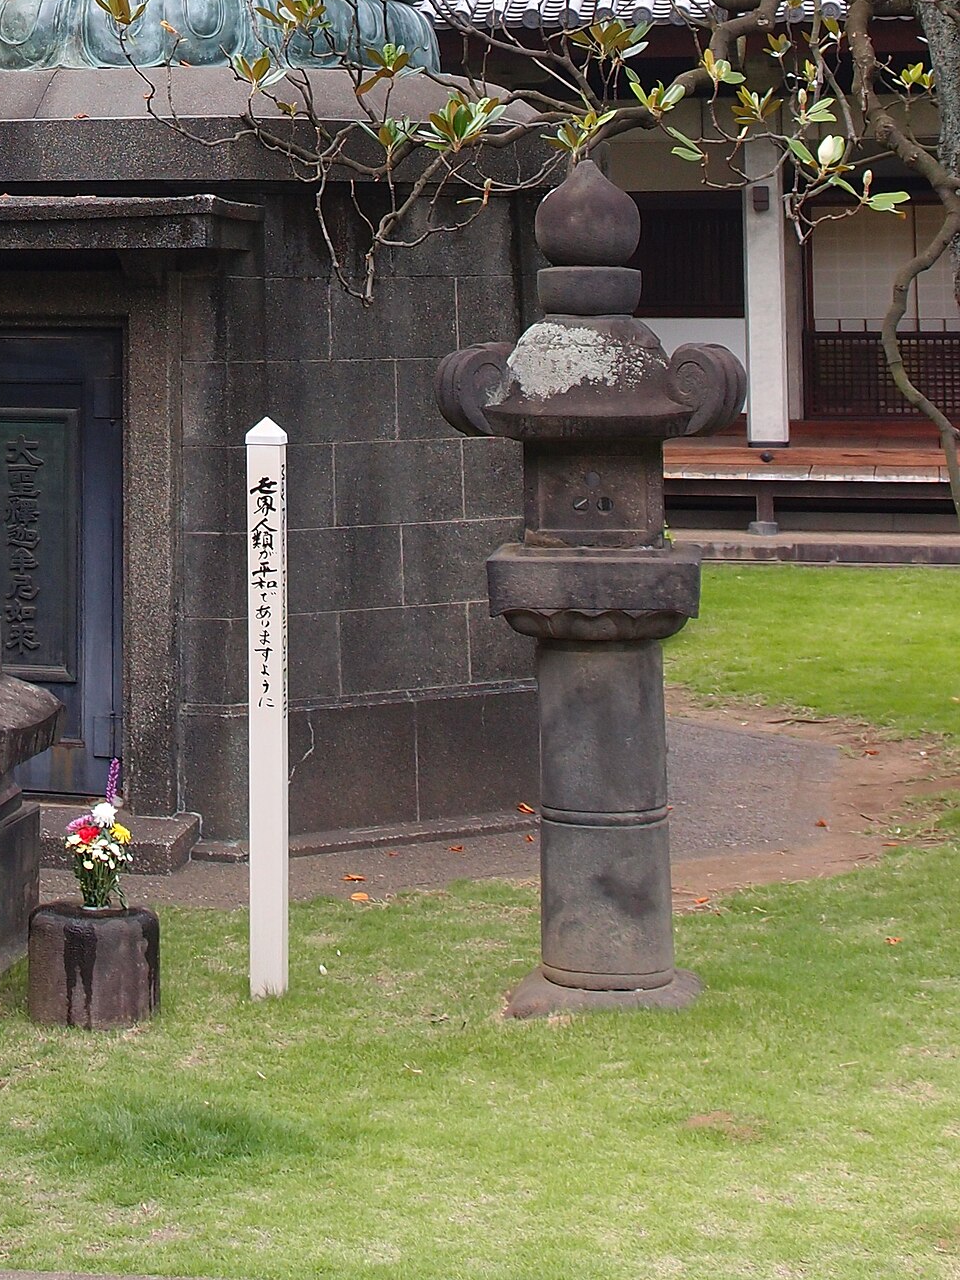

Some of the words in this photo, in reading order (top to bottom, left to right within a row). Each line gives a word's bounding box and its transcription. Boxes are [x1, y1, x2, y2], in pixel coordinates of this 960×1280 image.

[250, 477, 278, 708] 世界人類が平和でありますように
